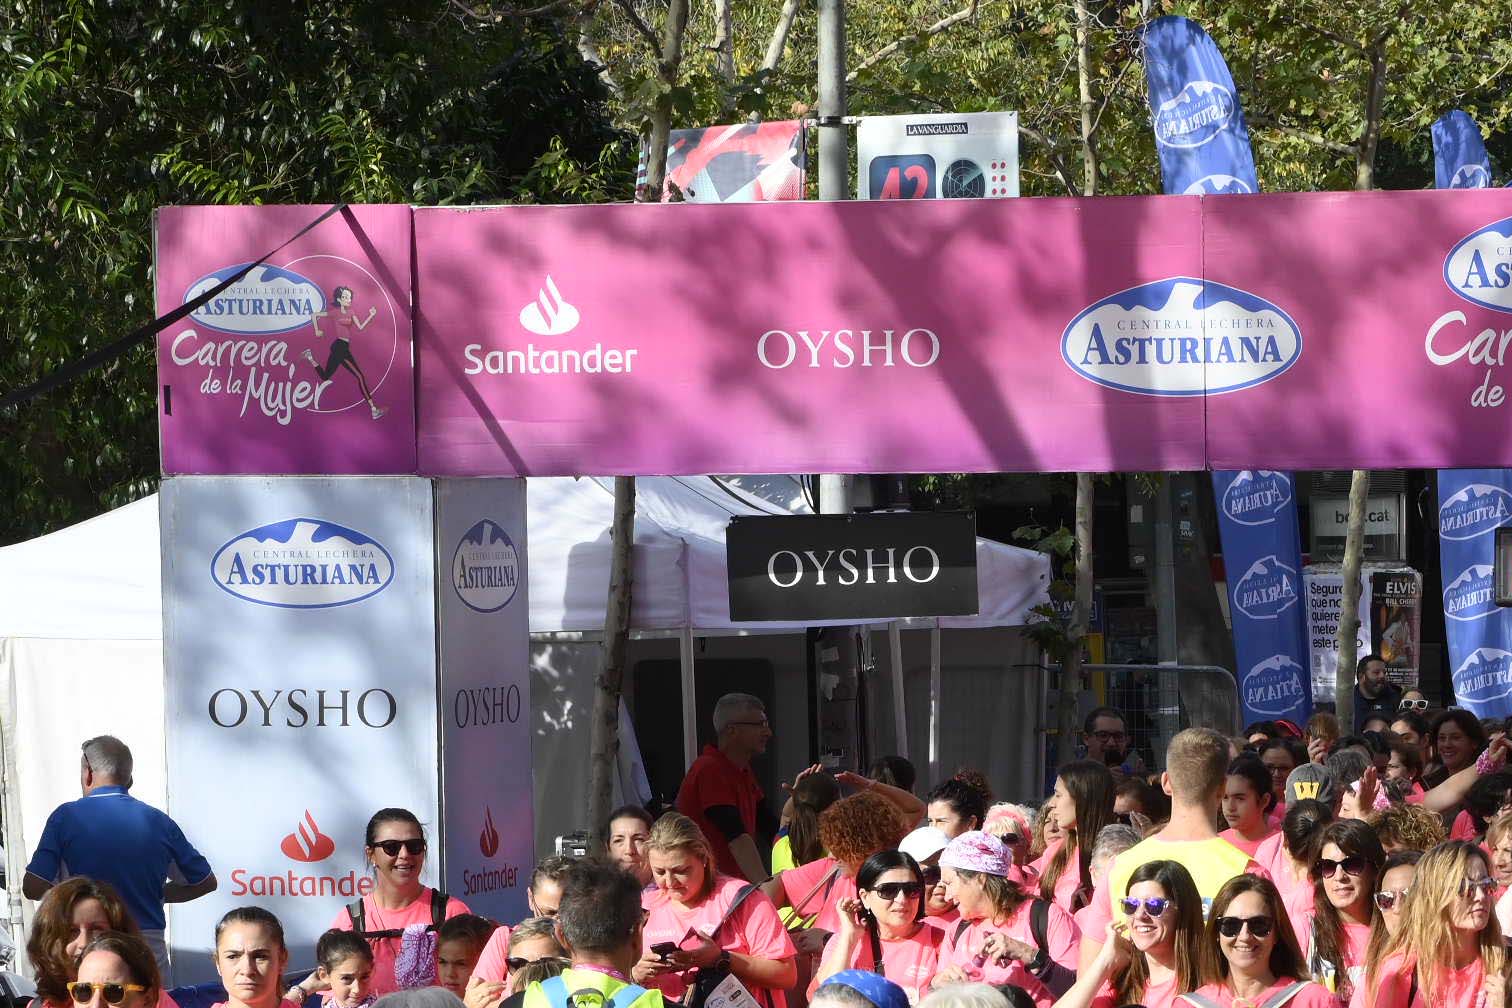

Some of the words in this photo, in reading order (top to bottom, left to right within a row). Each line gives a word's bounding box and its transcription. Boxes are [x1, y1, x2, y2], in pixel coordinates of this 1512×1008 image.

[1117, 319, 1192, 330] CENTRAL
[1201, 318, 1276, 329] LECHERA
[171, 329, 288, 367] Carrera
[465, 343, 637, 374] Santander
[756, 328, 940, 369] OYSHO
[1080, 323, 1283, 366] ASTURIANA
[200, 369, 222, 394] de
[227, 368, 242, 394] la
[240, 363, 333, 425] Mujer
[1470, 375, 1505, 408] de
[226, 552, 381, 586] ASTURIANA
[253, 549, 312, 559] CENTRAL
[317, 550, 375, 559] LECHERA
[767, 545, 940, 588] OYSHO
[457, 555, 515, 589] ASTURIANA
[1386, 582, 1416, 593] ELVIS
[1311, 599, 1327, 609] que
[1312, 612, 1343, 621] quiere
[1313, 639, 1331, 648] este
[208, 688, 397, 728] OYSHO
[454, 684, 521, 729] OYSHO
[230, 869, 374, 897] Santande
[463, 863, 519, 896] Santander
